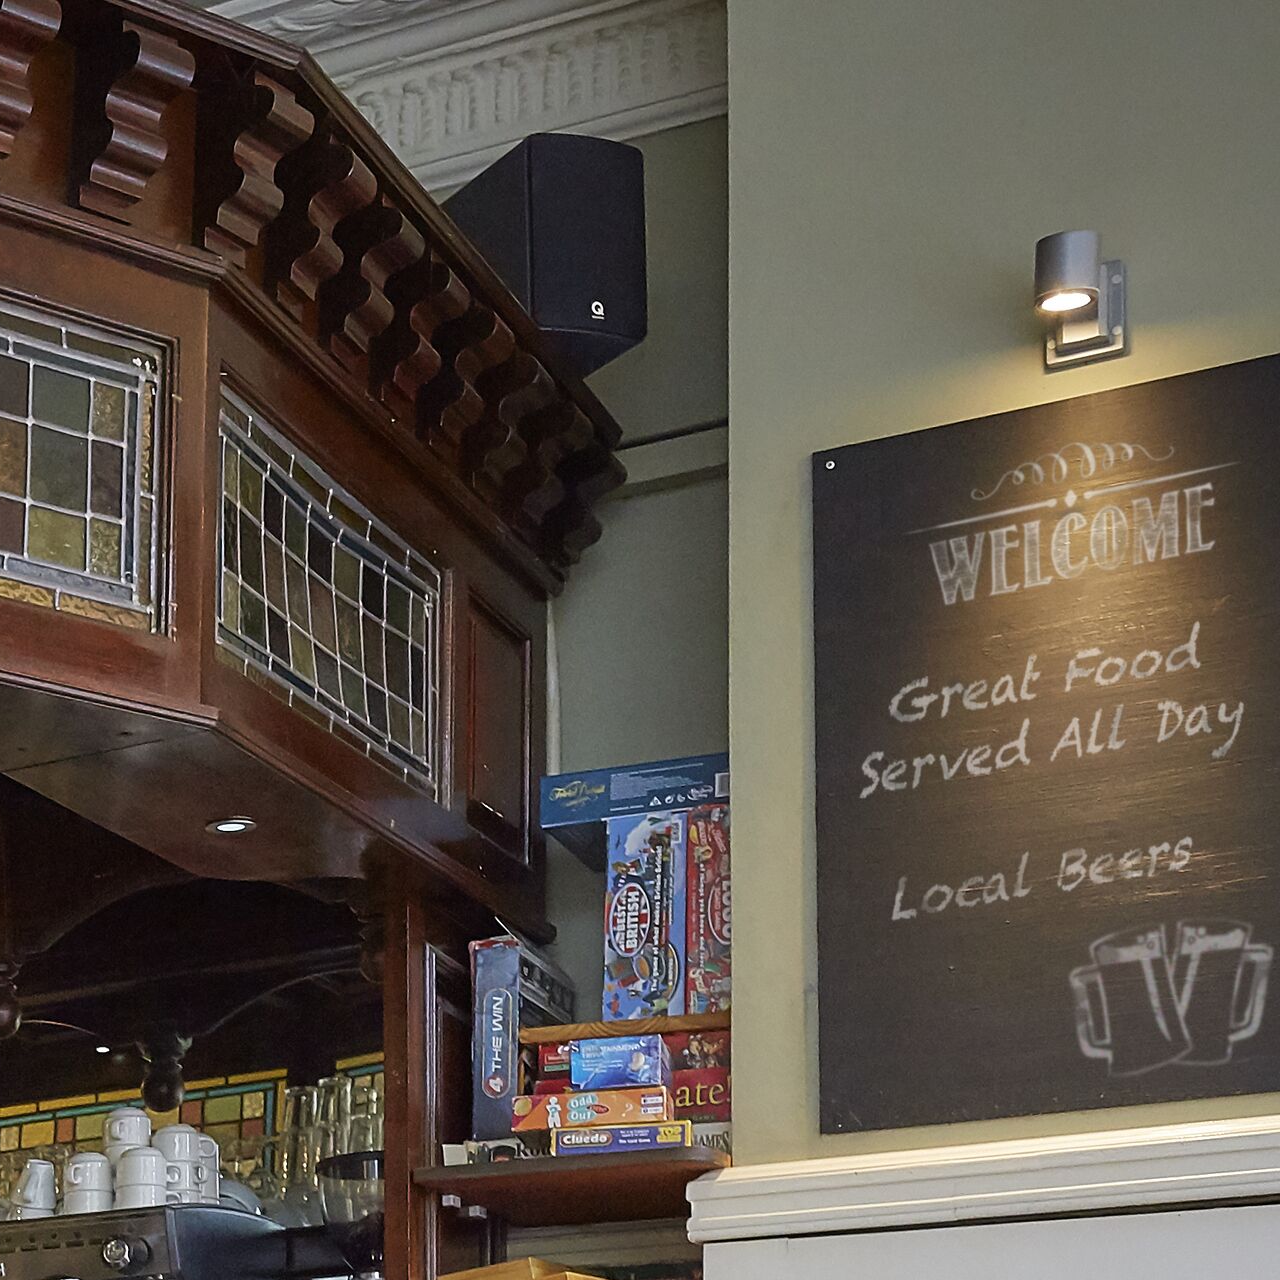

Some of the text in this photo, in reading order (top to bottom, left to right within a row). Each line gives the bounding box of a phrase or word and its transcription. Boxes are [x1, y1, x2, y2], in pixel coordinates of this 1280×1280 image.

[929, 482, 1216, 606] WELCOME
[888, 620, 1202, 725] Great Food
[859, 700, 1245, 799] Served All Day
[891, 834, 1194, 922] Local Beers
[615, 905, 627, 931] BEST
[626, 891, 640, 949] BRITISH
[488, 997, 504, 1093] 4 THE WIN
[570, 1094, 593, 1109] Odd
[570, 1111, 592, 1121] Out
[562, 1132, 609, 1145] Cluedo
